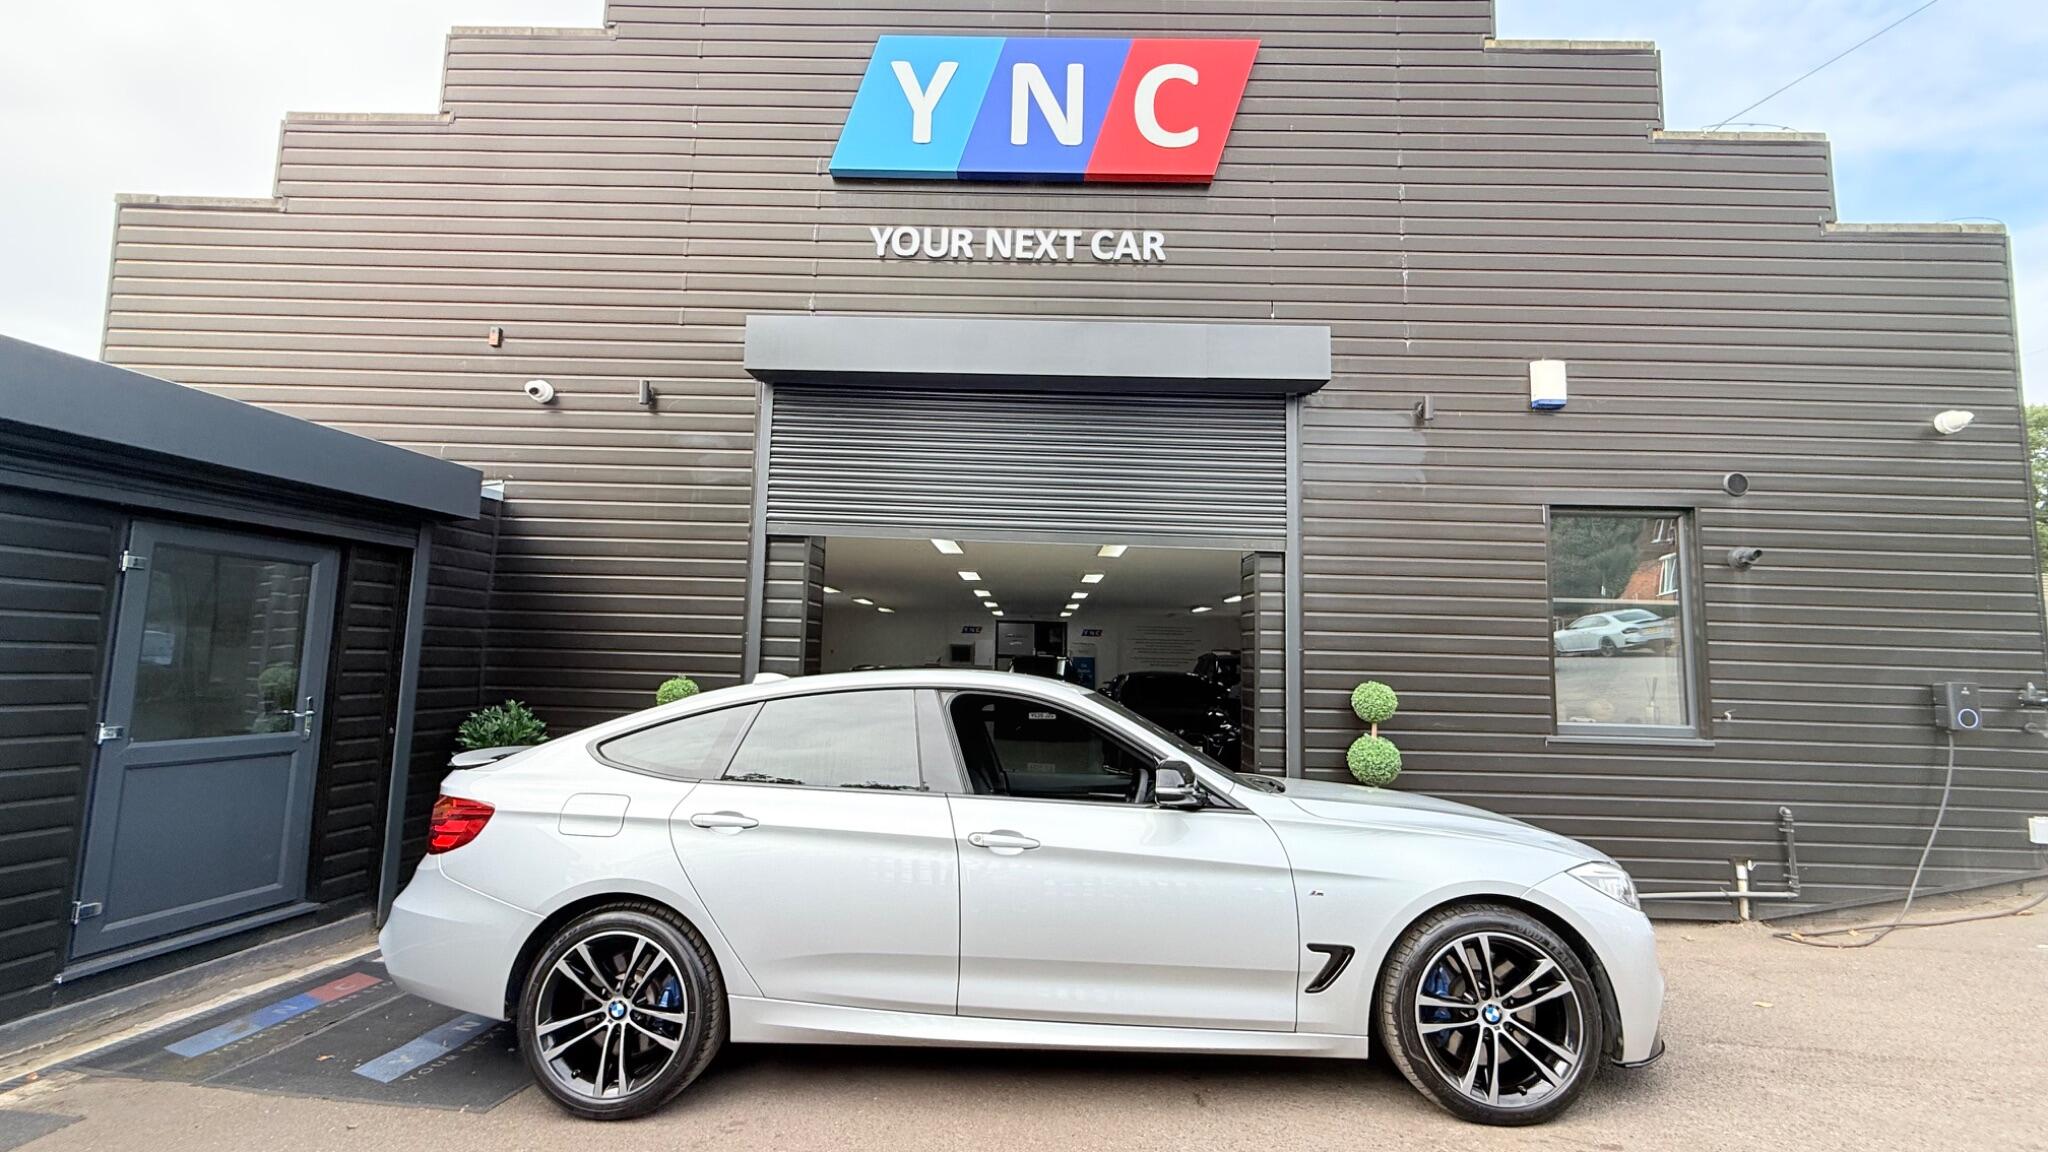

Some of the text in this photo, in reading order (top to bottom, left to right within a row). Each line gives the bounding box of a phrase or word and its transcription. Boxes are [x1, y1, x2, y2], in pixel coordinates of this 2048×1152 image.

[890, 60, 1200, 149] YNC
[869, 226, 1167, 262] YOUR NEXT CAR
